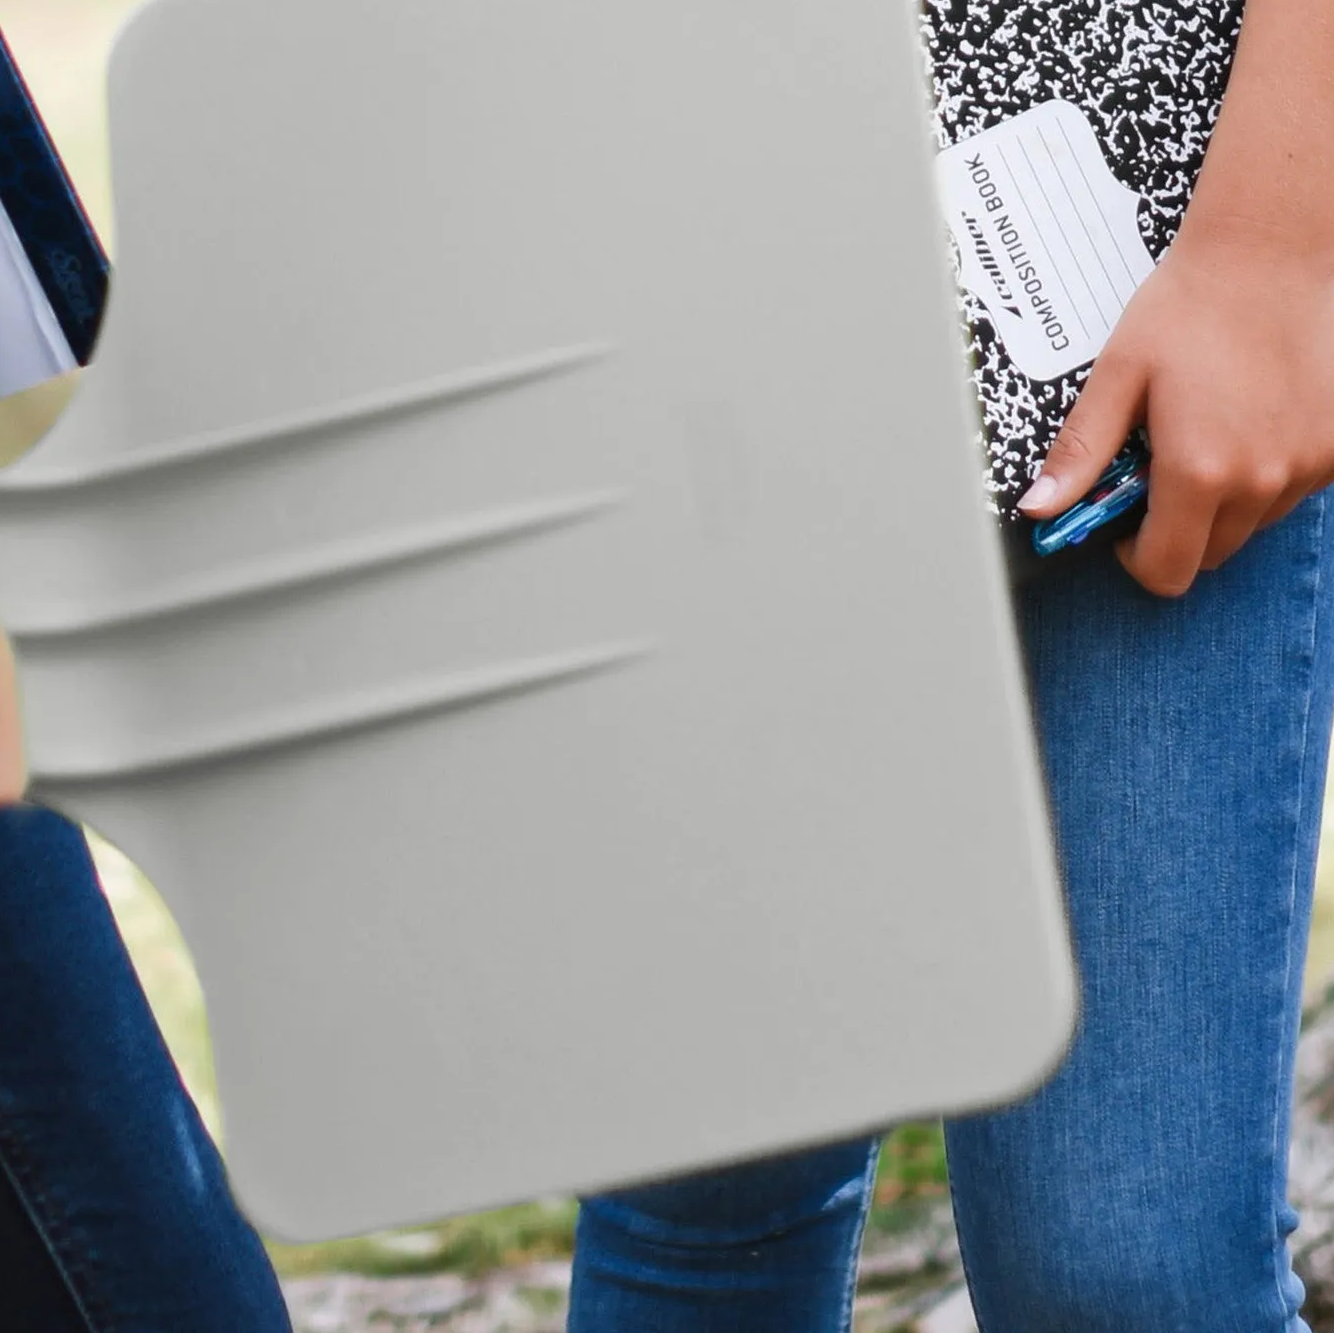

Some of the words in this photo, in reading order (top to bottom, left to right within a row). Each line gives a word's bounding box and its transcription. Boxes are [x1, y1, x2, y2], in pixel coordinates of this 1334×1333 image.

[964, 152, 1004, 213] BOOK
[961, 211, 1013, 300] caliber
[993, 214, 1070, 351] COMPOSITION
